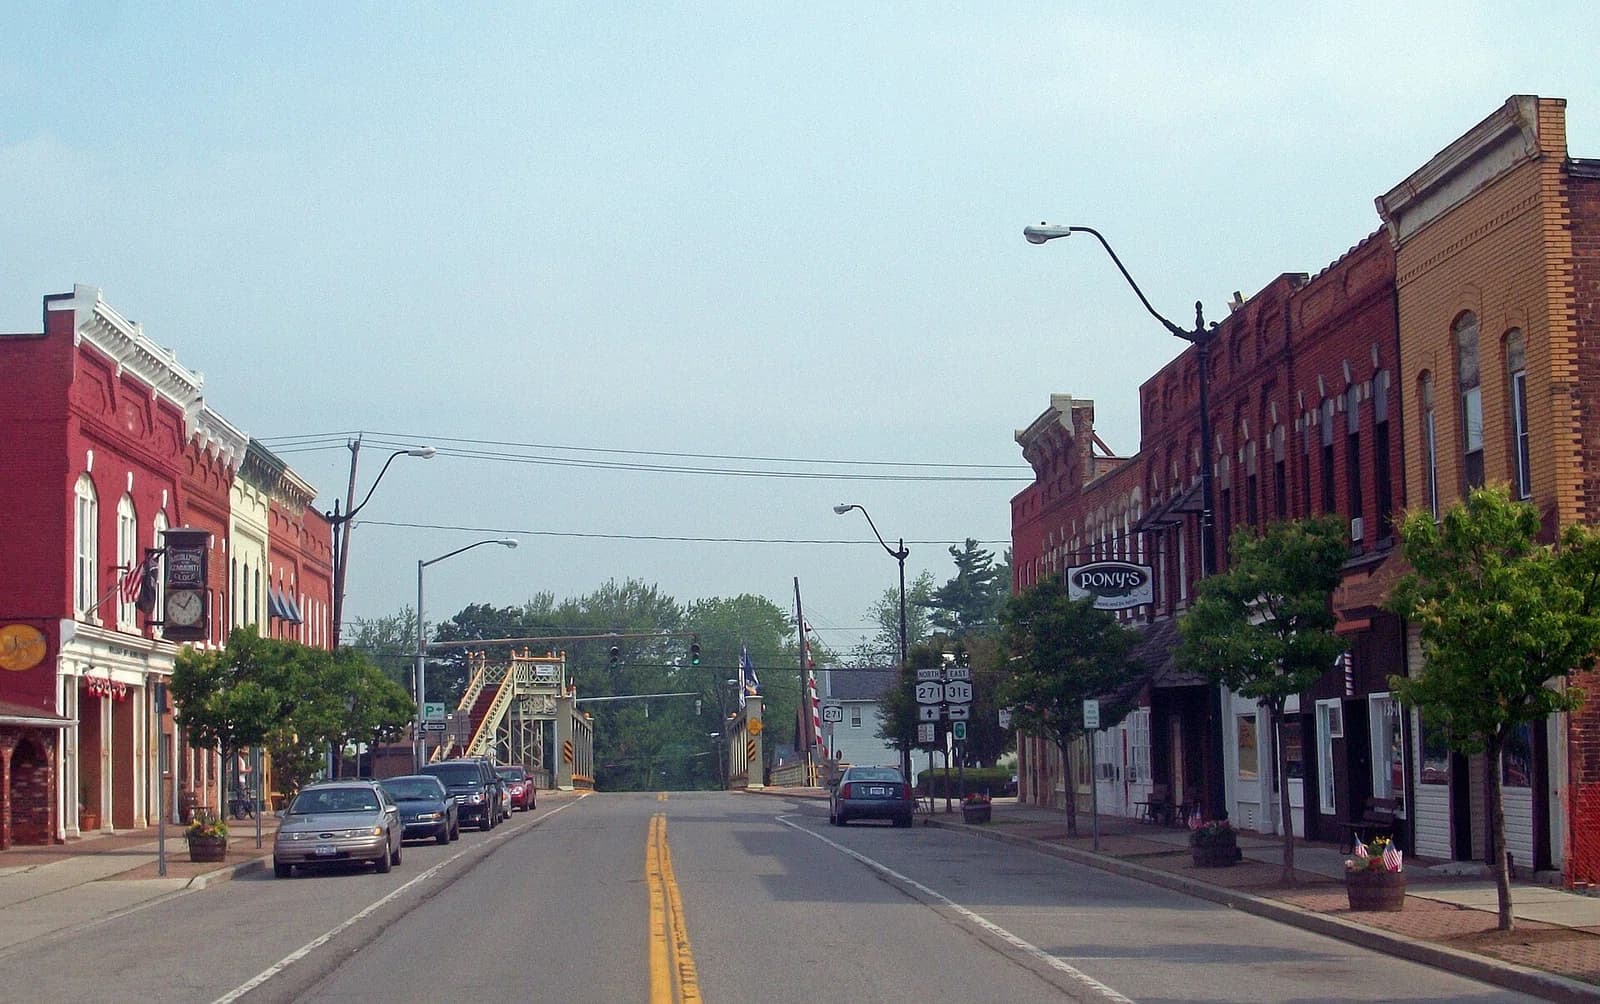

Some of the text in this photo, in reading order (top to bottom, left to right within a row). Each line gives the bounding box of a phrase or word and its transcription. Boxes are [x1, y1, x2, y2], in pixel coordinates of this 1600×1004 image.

[1081, 572, 1140, 589] PONY'S
[919, 687, 940, 698] 271
[949, 687, 969, 698] 31E
[426, 706, 434, 717] P
[825, 710, 841, 719] 271
